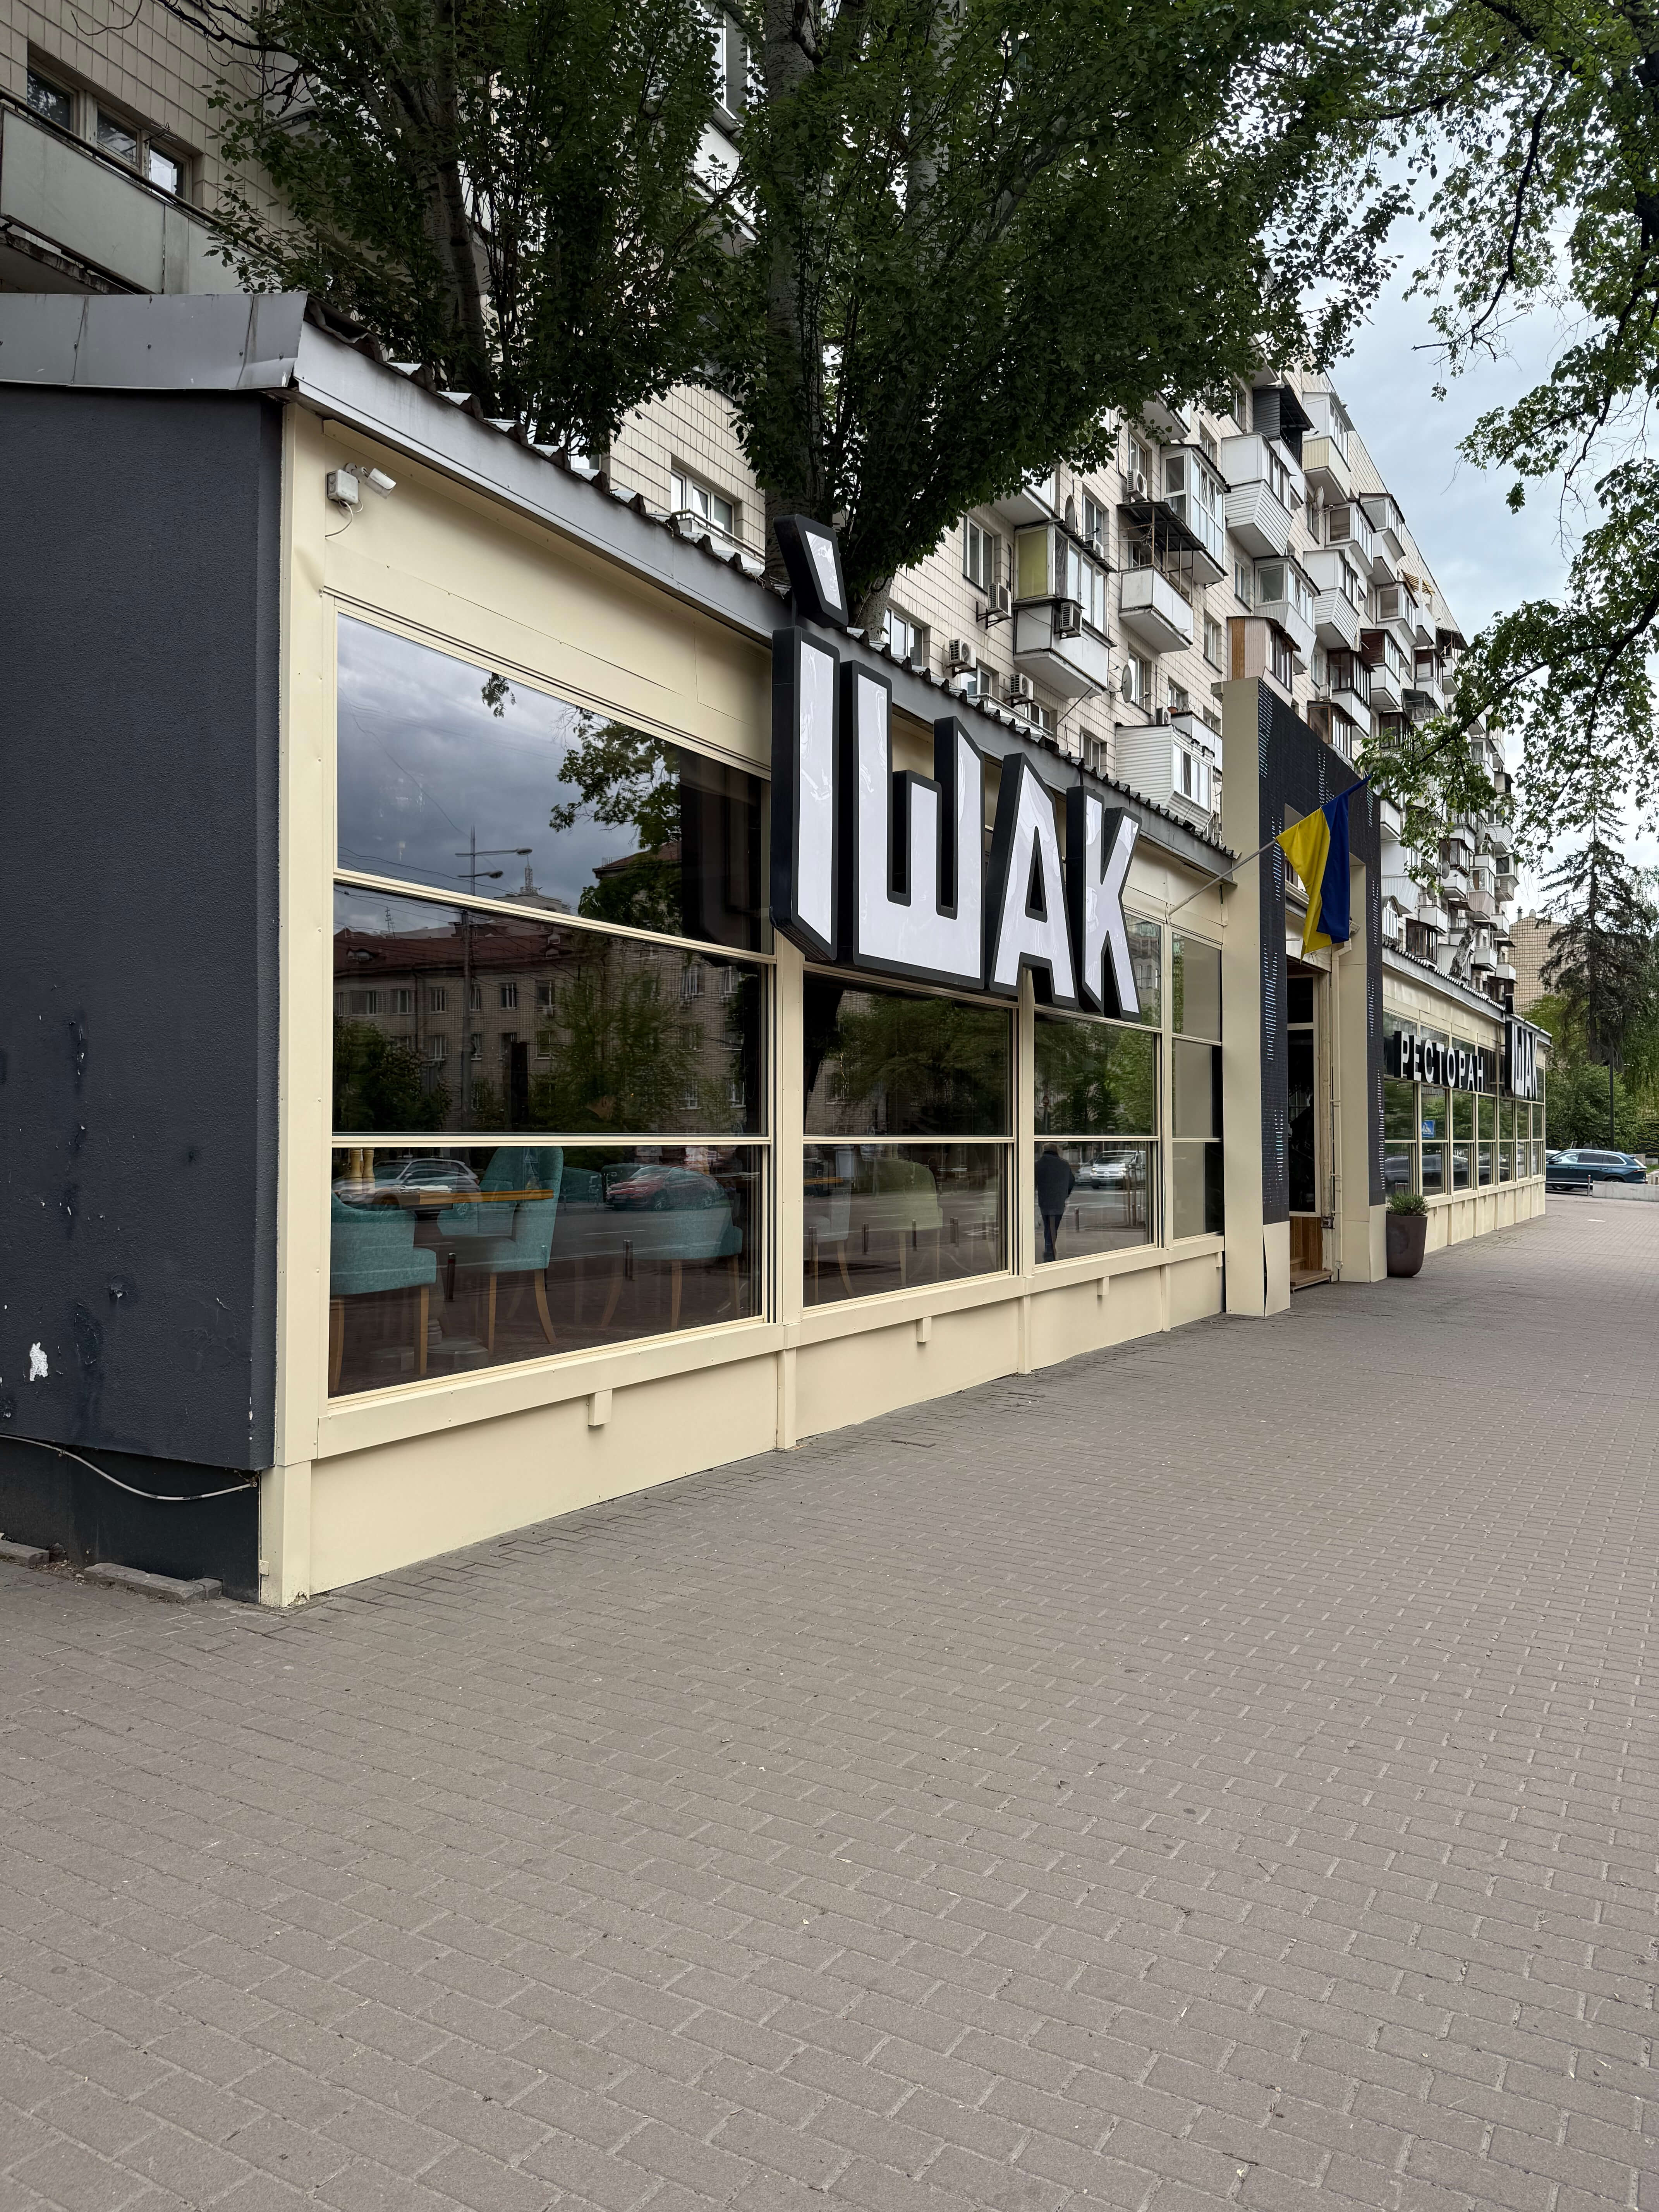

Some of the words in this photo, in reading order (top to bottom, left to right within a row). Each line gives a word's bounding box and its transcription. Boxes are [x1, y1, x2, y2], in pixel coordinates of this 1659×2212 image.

[791, 521, 1142, 1019] ІШАК
[1400, 1031, 1484, 1092] РЕСТОРАН
[1508, 994, 1538, 1101] ІШАК
